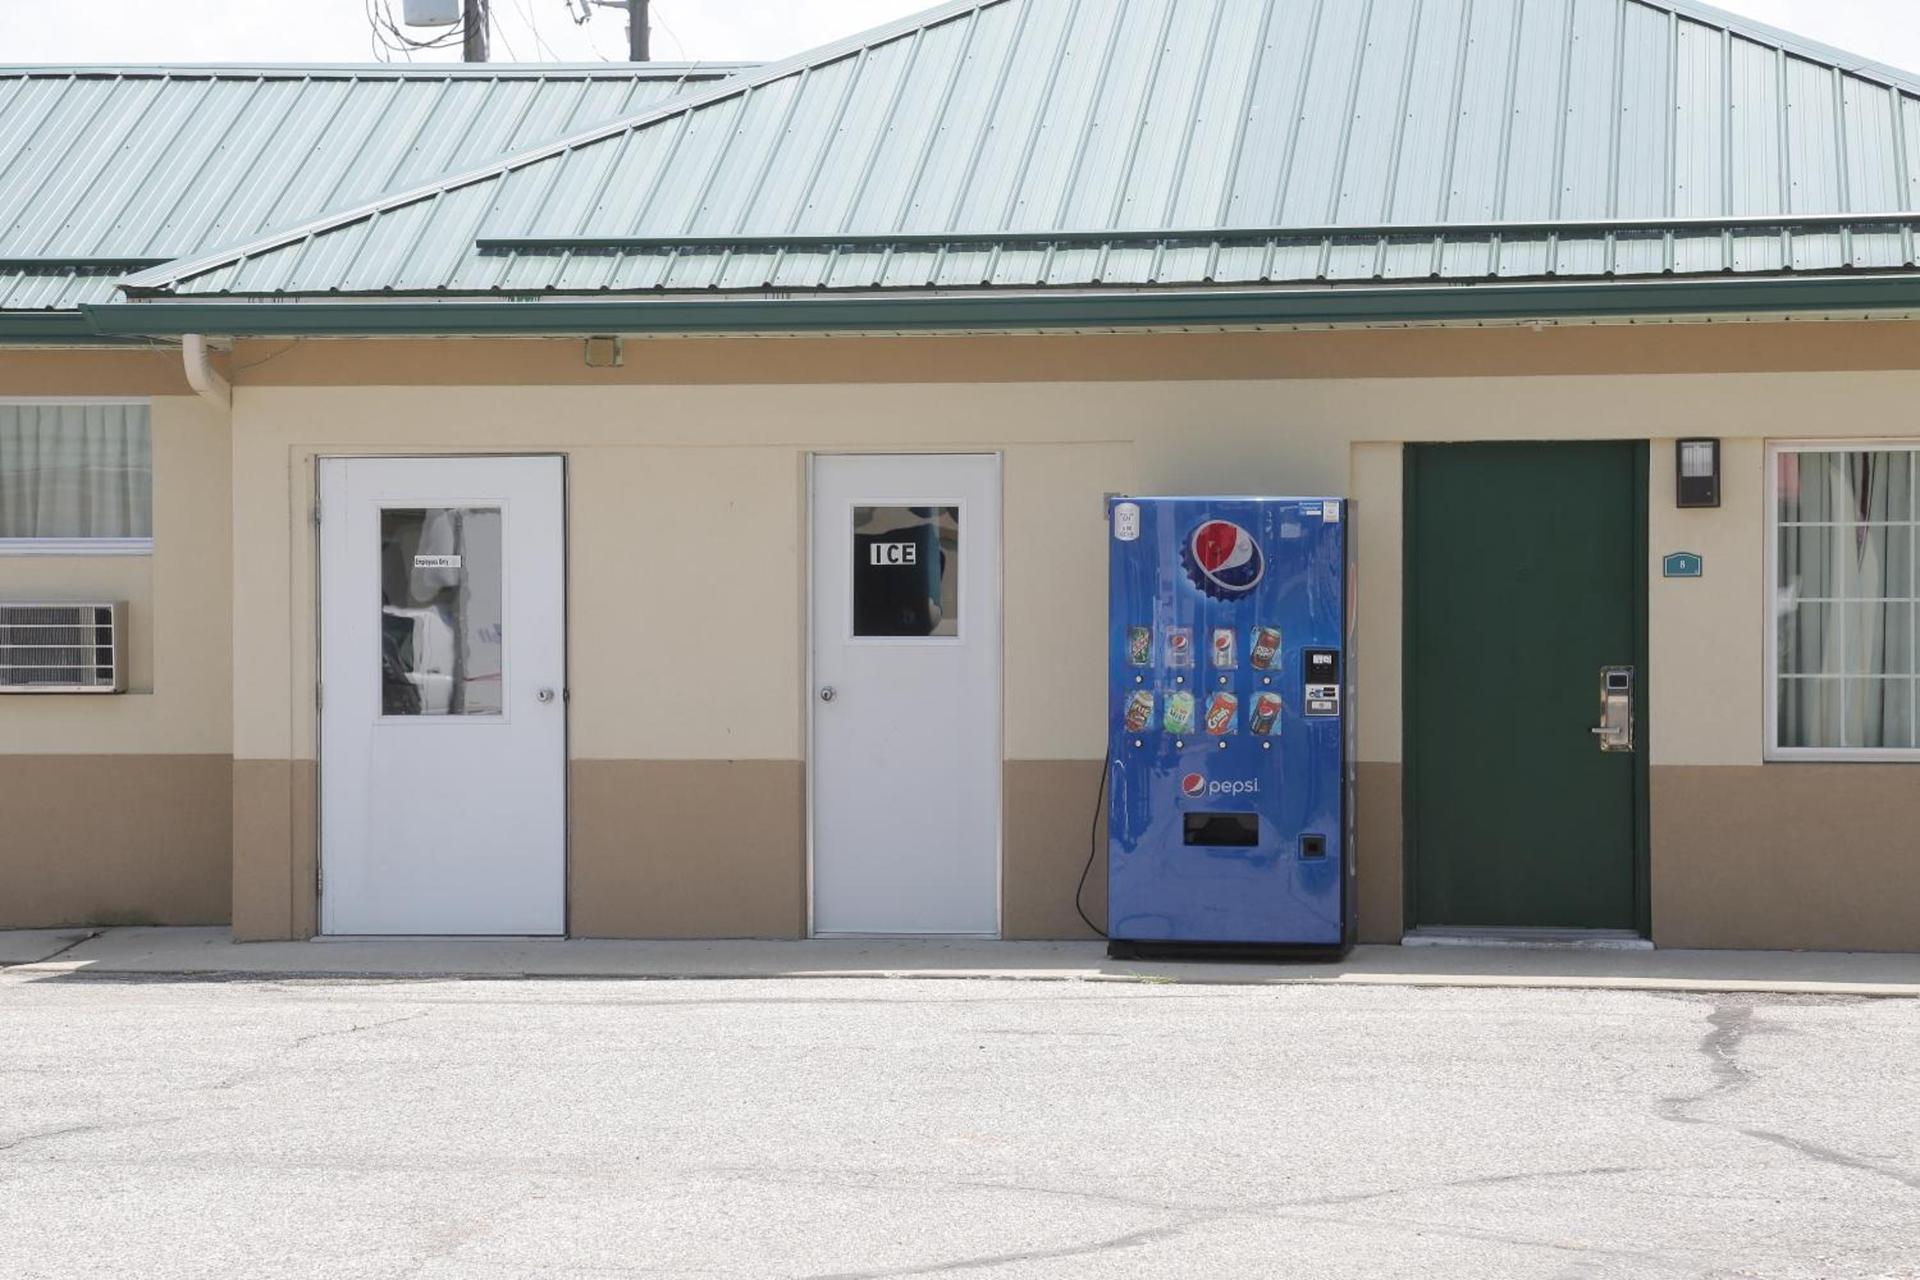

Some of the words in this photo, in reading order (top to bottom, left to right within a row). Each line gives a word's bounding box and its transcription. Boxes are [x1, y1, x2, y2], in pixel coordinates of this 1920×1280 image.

[876, 544, 914, 564] ICE
[1679, 560, 1686, 569] 8
[1208, 778, 1258, 797] pepsi
